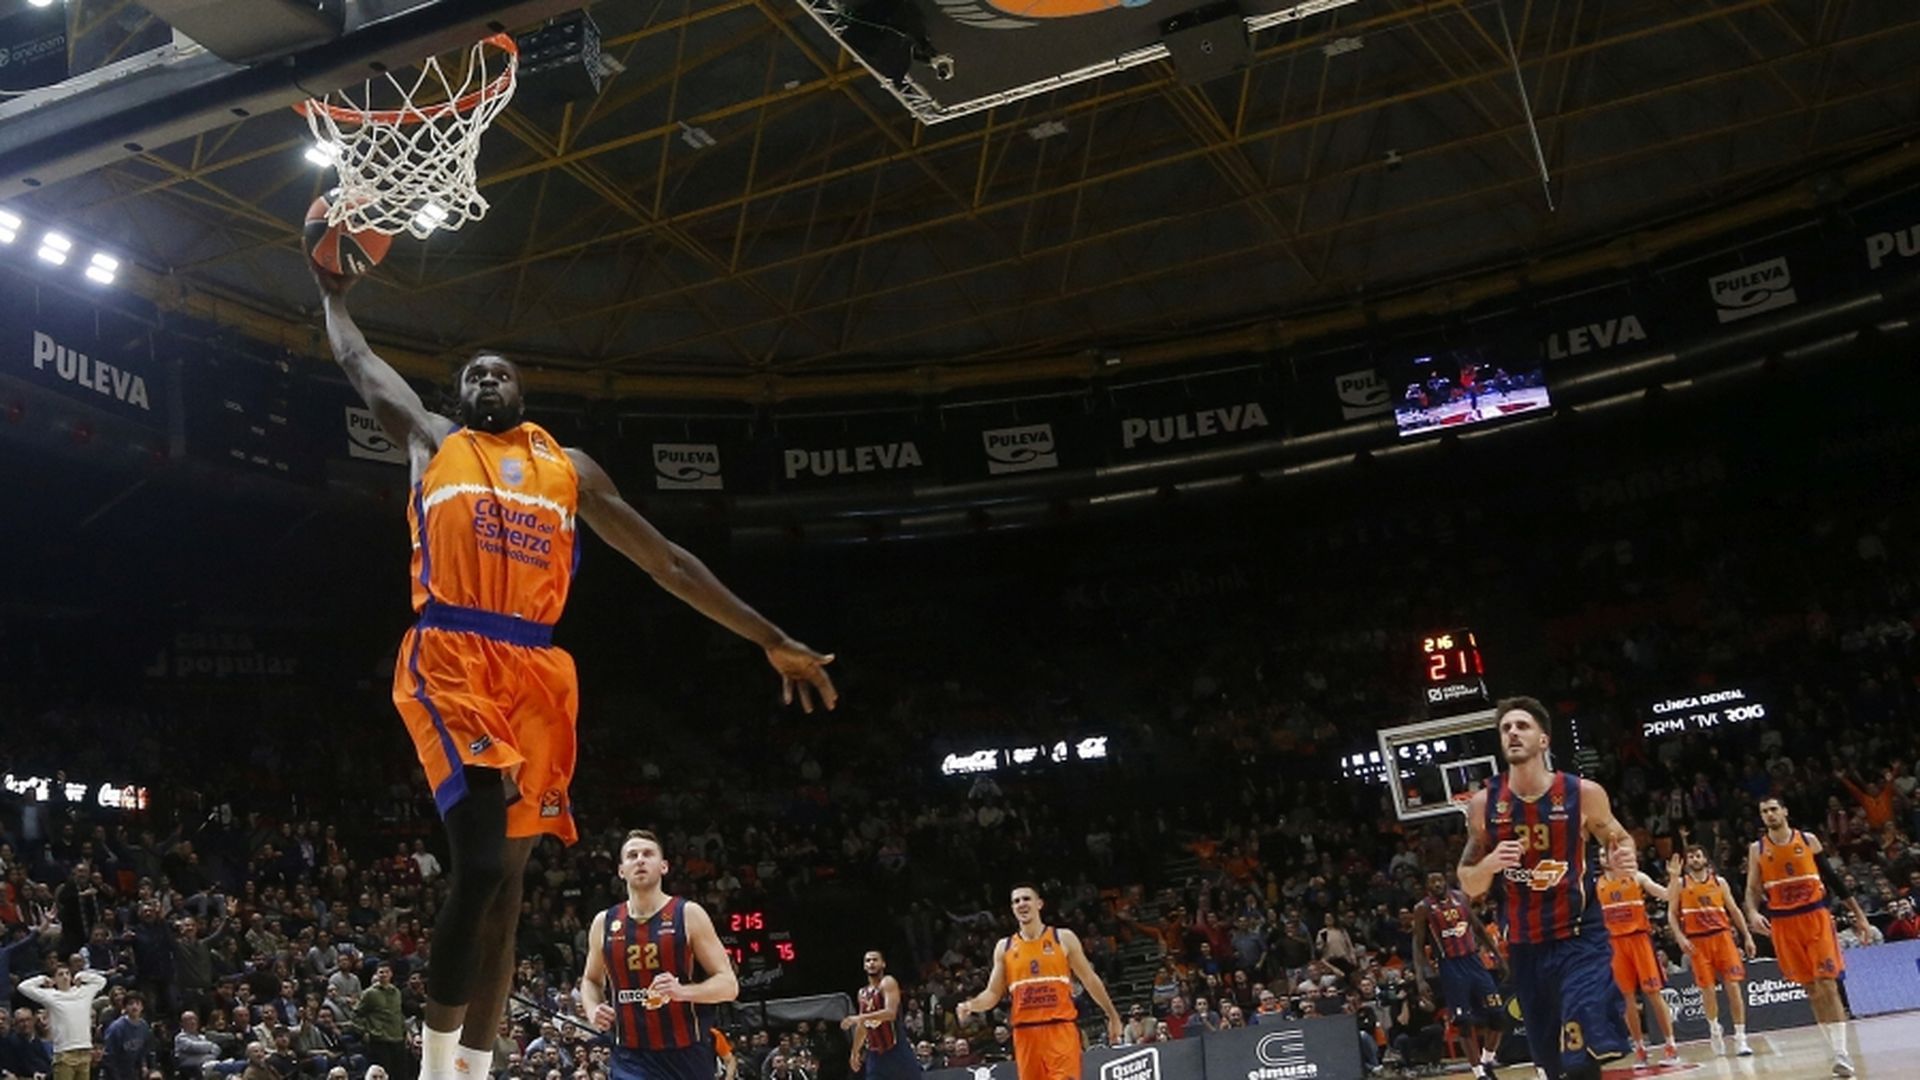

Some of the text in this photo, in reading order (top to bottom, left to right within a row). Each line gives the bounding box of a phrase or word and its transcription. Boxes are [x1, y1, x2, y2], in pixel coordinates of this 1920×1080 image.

[1716, 266, 1785, 295] PULEVA
[1541, 315, 1647, 360] LEVA
[33, 330, 150, 411] PULEVA
[1122, 402, 1269, 449] PULEVA
[988, 431, 1050, 448] PULEVA
[658, 449, 716, 464] PULEVA
[784, 442, 923, 479] PULEVA
[175, 652, 298, 678] popular
[1700, 689, 1745, 705] DENTAL
[627, 943, 659, 971] 22
[775, 942, 796, 962] 75
[1113, 1058, 1148, 1078] Oscar
